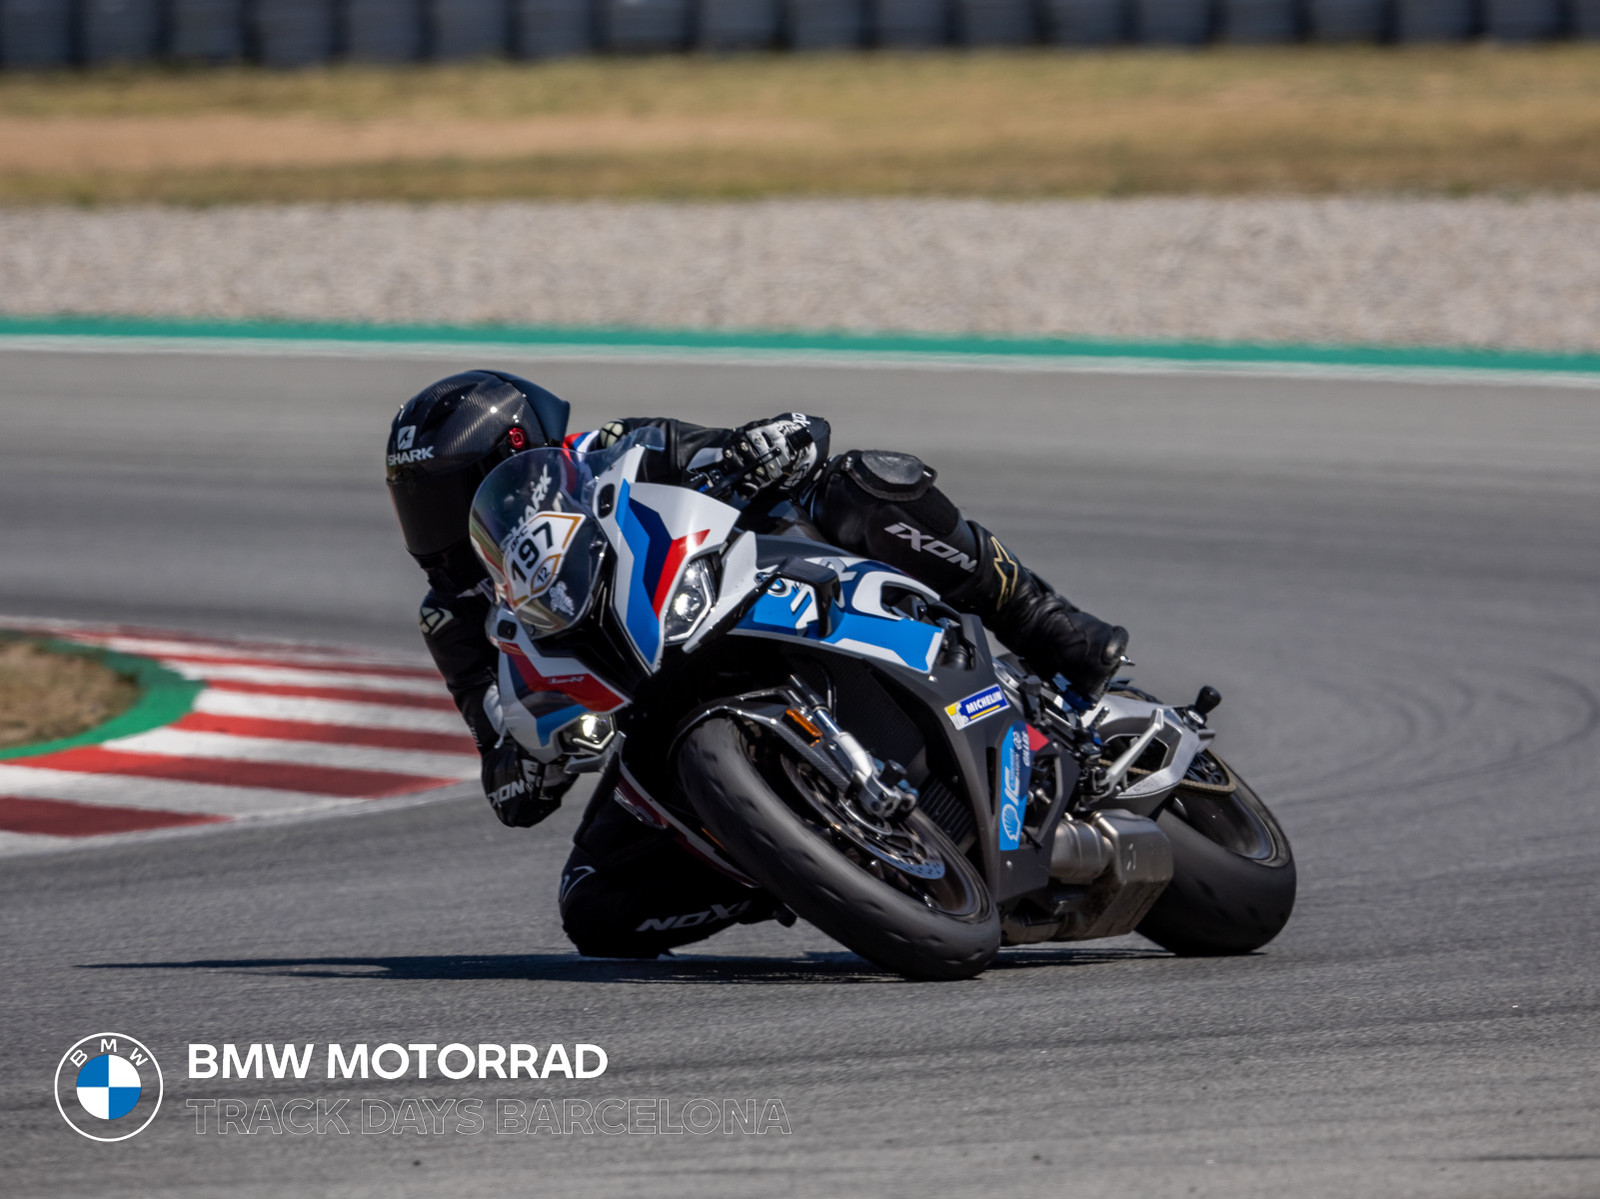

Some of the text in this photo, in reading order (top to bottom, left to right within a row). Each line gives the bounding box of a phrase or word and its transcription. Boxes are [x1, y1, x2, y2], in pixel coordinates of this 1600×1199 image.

[388, 445, 435, 466] SHARK
[511, 521, 554, 584] 197
[536, 566, 551, 584] 12
[965, 690, 1003, 714] MICHELIN
